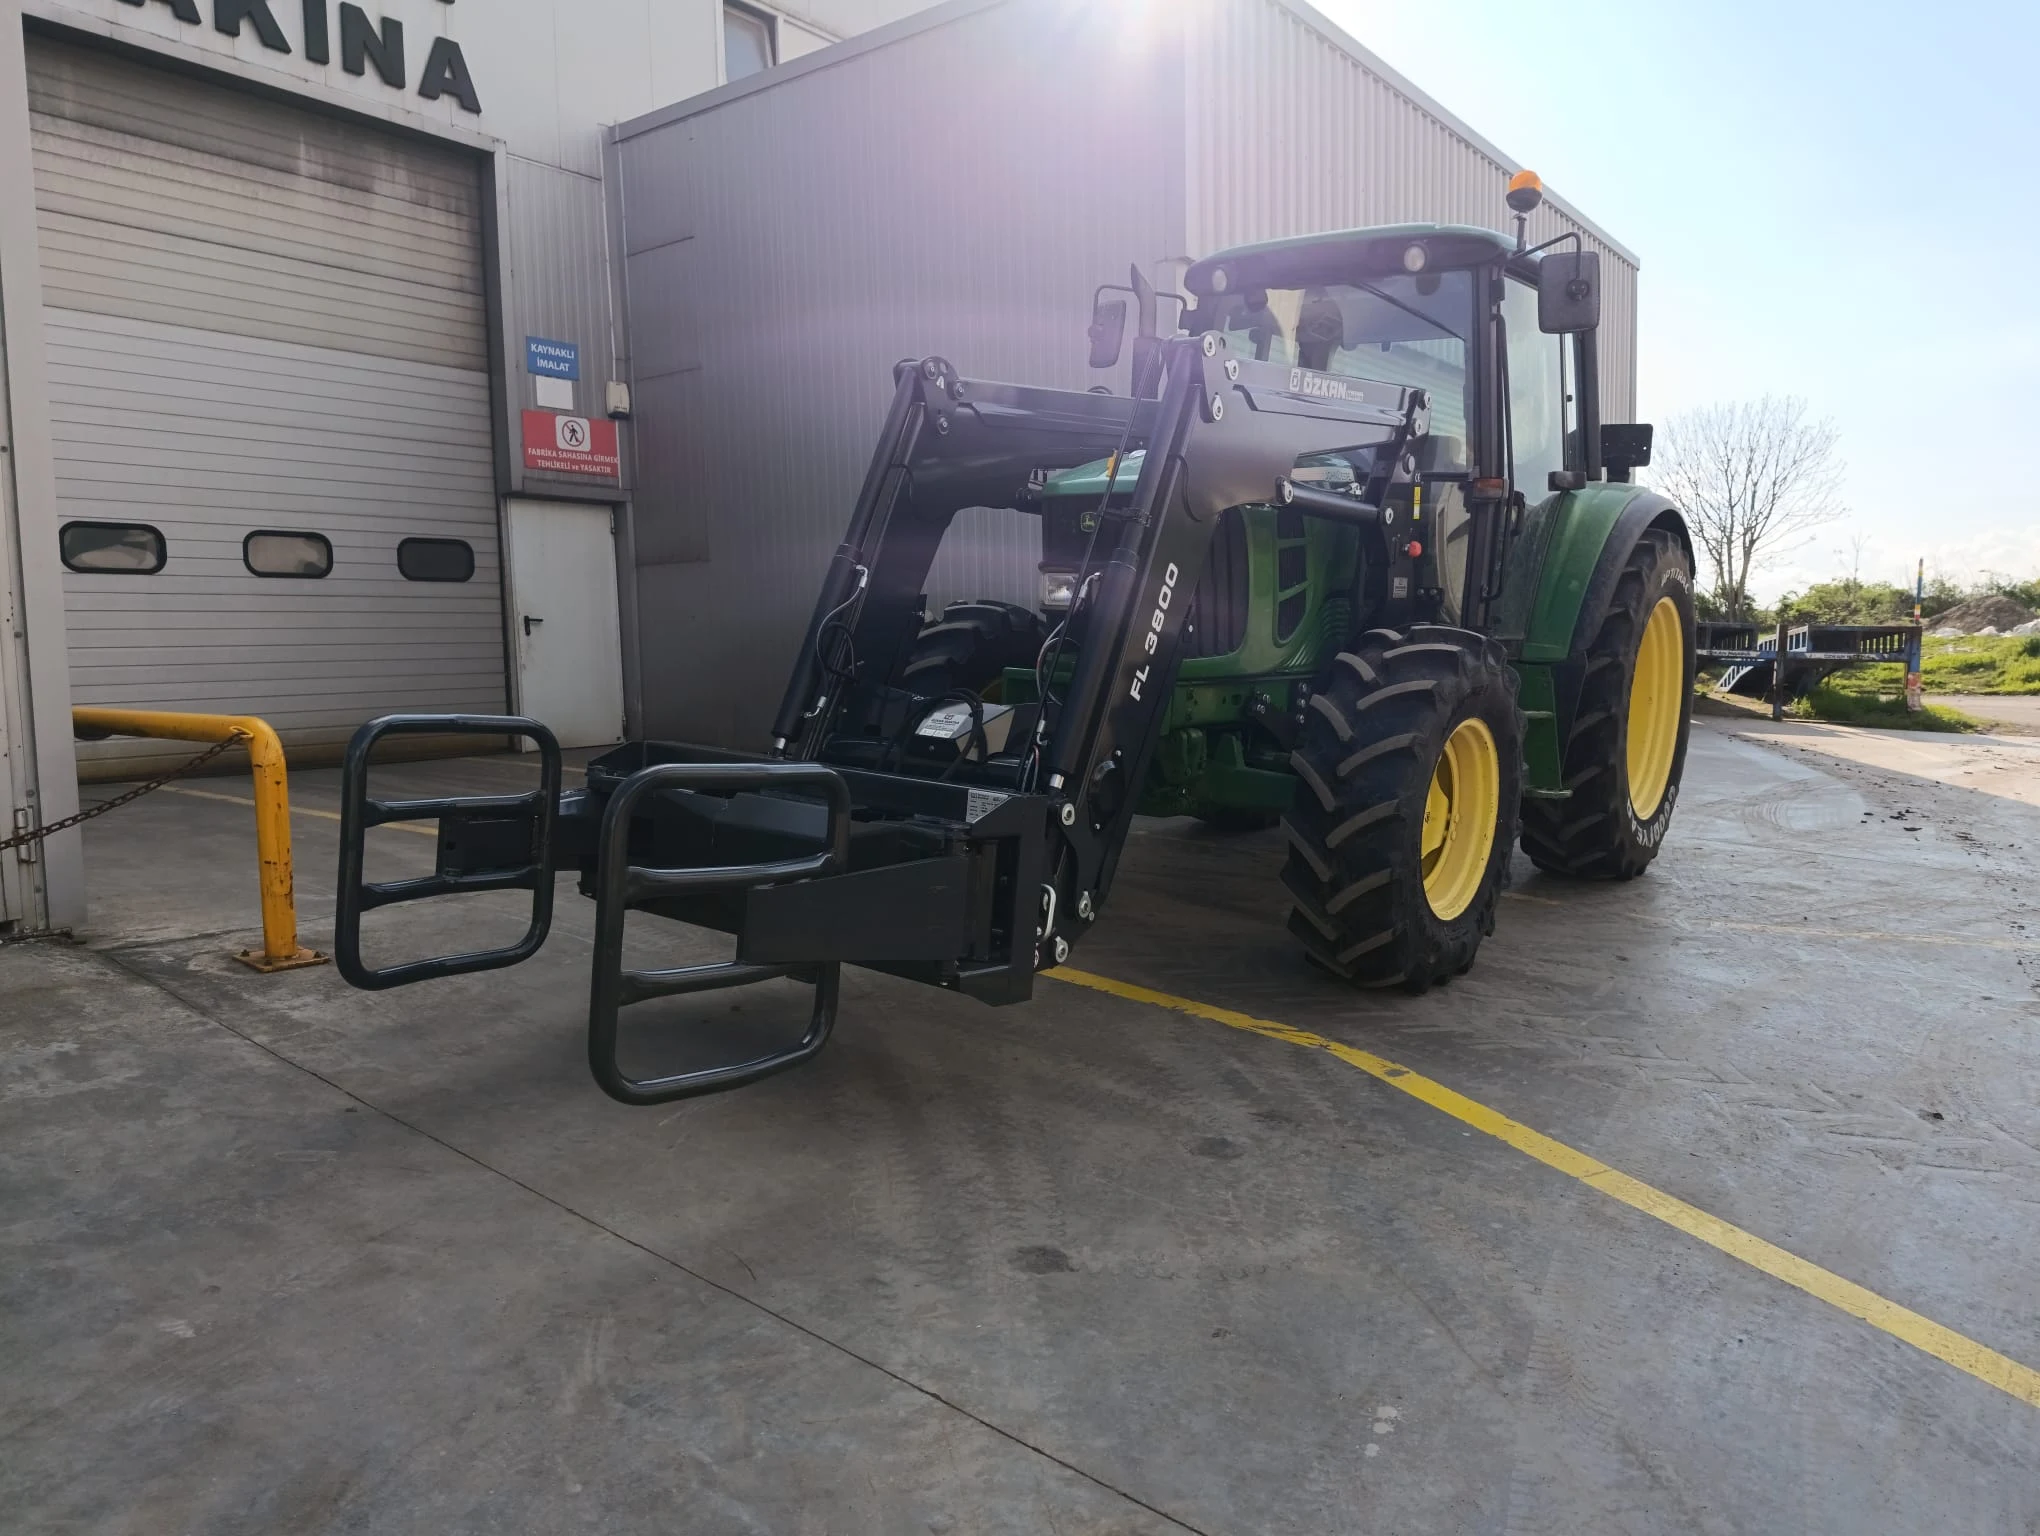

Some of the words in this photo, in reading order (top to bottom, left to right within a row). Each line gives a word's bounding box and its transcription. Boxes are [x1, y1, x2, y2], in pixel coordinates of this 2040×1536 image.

[530, 343, 575, 359] KAYNAKLI
[536, 357, 570, 372] İMALAT
[1303, 371, 1347, 400] ÖZKAN
[528, 447, 557, 458] FABRİKA
[558, 450, 592, 462] SAHASINA
[593, 454, 618, 464] GİRMEK
[537, 459, 571, 470] TEHLİKELİ
[580, 463, 612, 474] YASAKTIR
[1144, 562, 1179, 655] 3800
